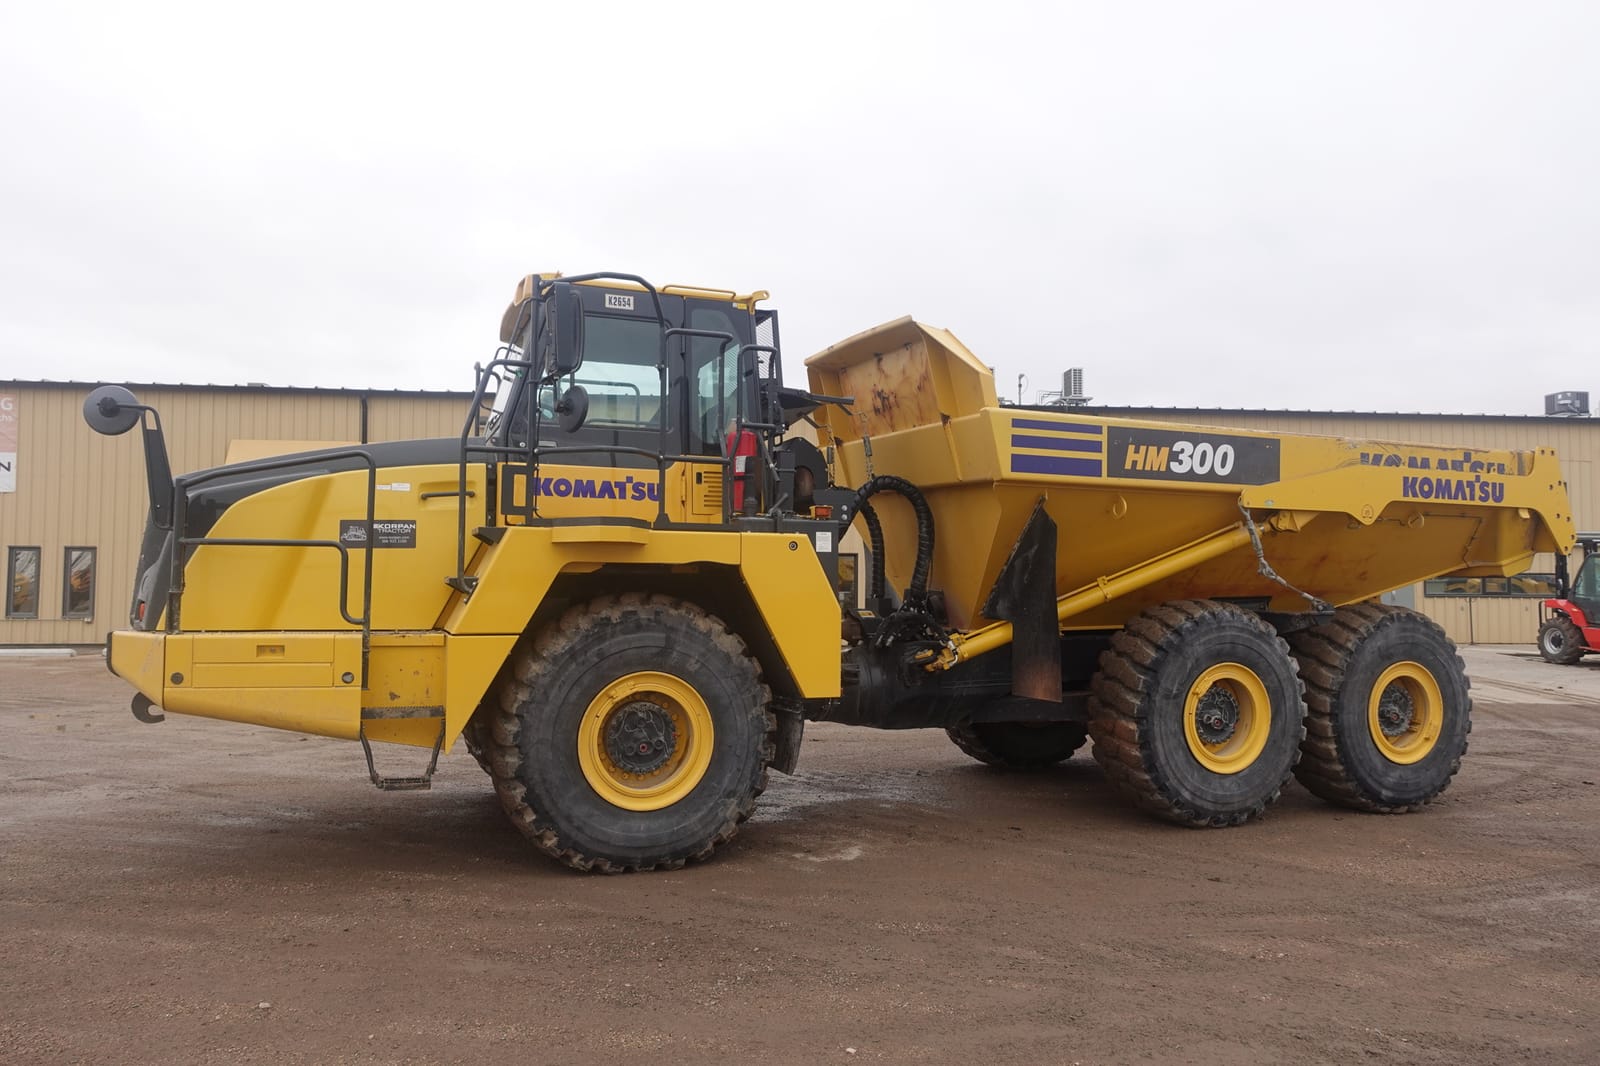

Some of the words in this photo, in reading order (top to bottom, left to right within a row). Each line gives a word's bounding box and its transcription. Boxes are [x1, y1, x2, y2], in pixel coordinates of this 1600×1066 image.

[608, 295, 631, 307] K2654
[1124, 441, 1235, 476] HM300
[533, 476, 660, 501] KOMATSU
[1402, 475, 1504, 503] KOMATSU
